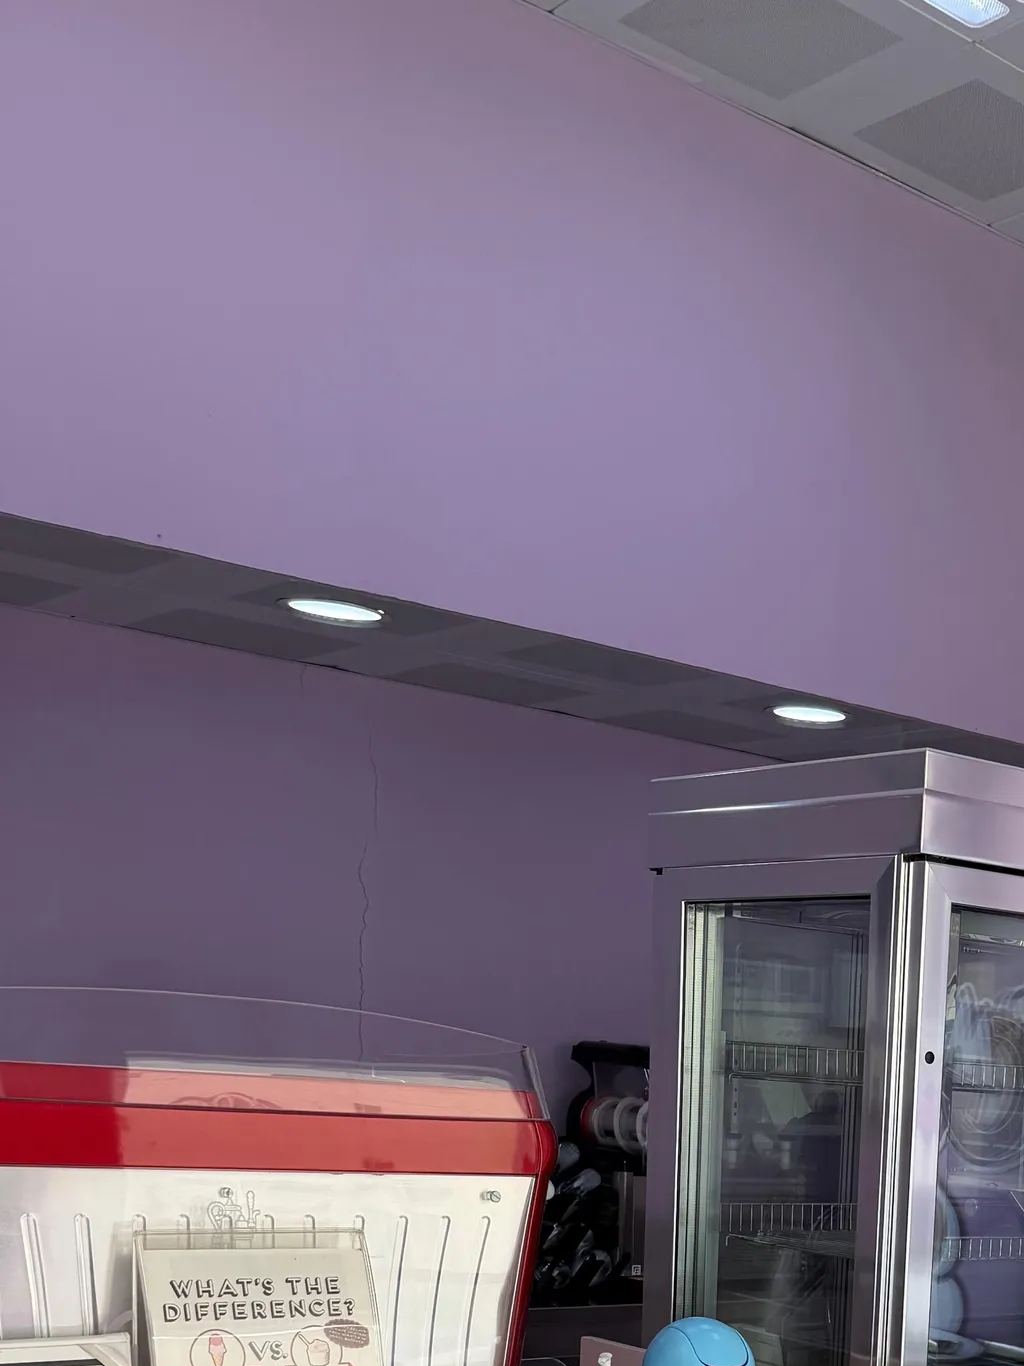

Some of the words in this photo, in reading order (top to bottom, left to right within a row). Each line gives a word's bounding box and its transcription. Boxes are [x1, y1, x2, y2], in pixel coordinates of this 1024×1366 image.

[170, 1278, 275, 1299] WHAT'S
[285, 1276, 341, 1295] THE
[162, 1298, 356, 1323] DIFFERENCE?
[248, 1340, 288, 1362] VS.
